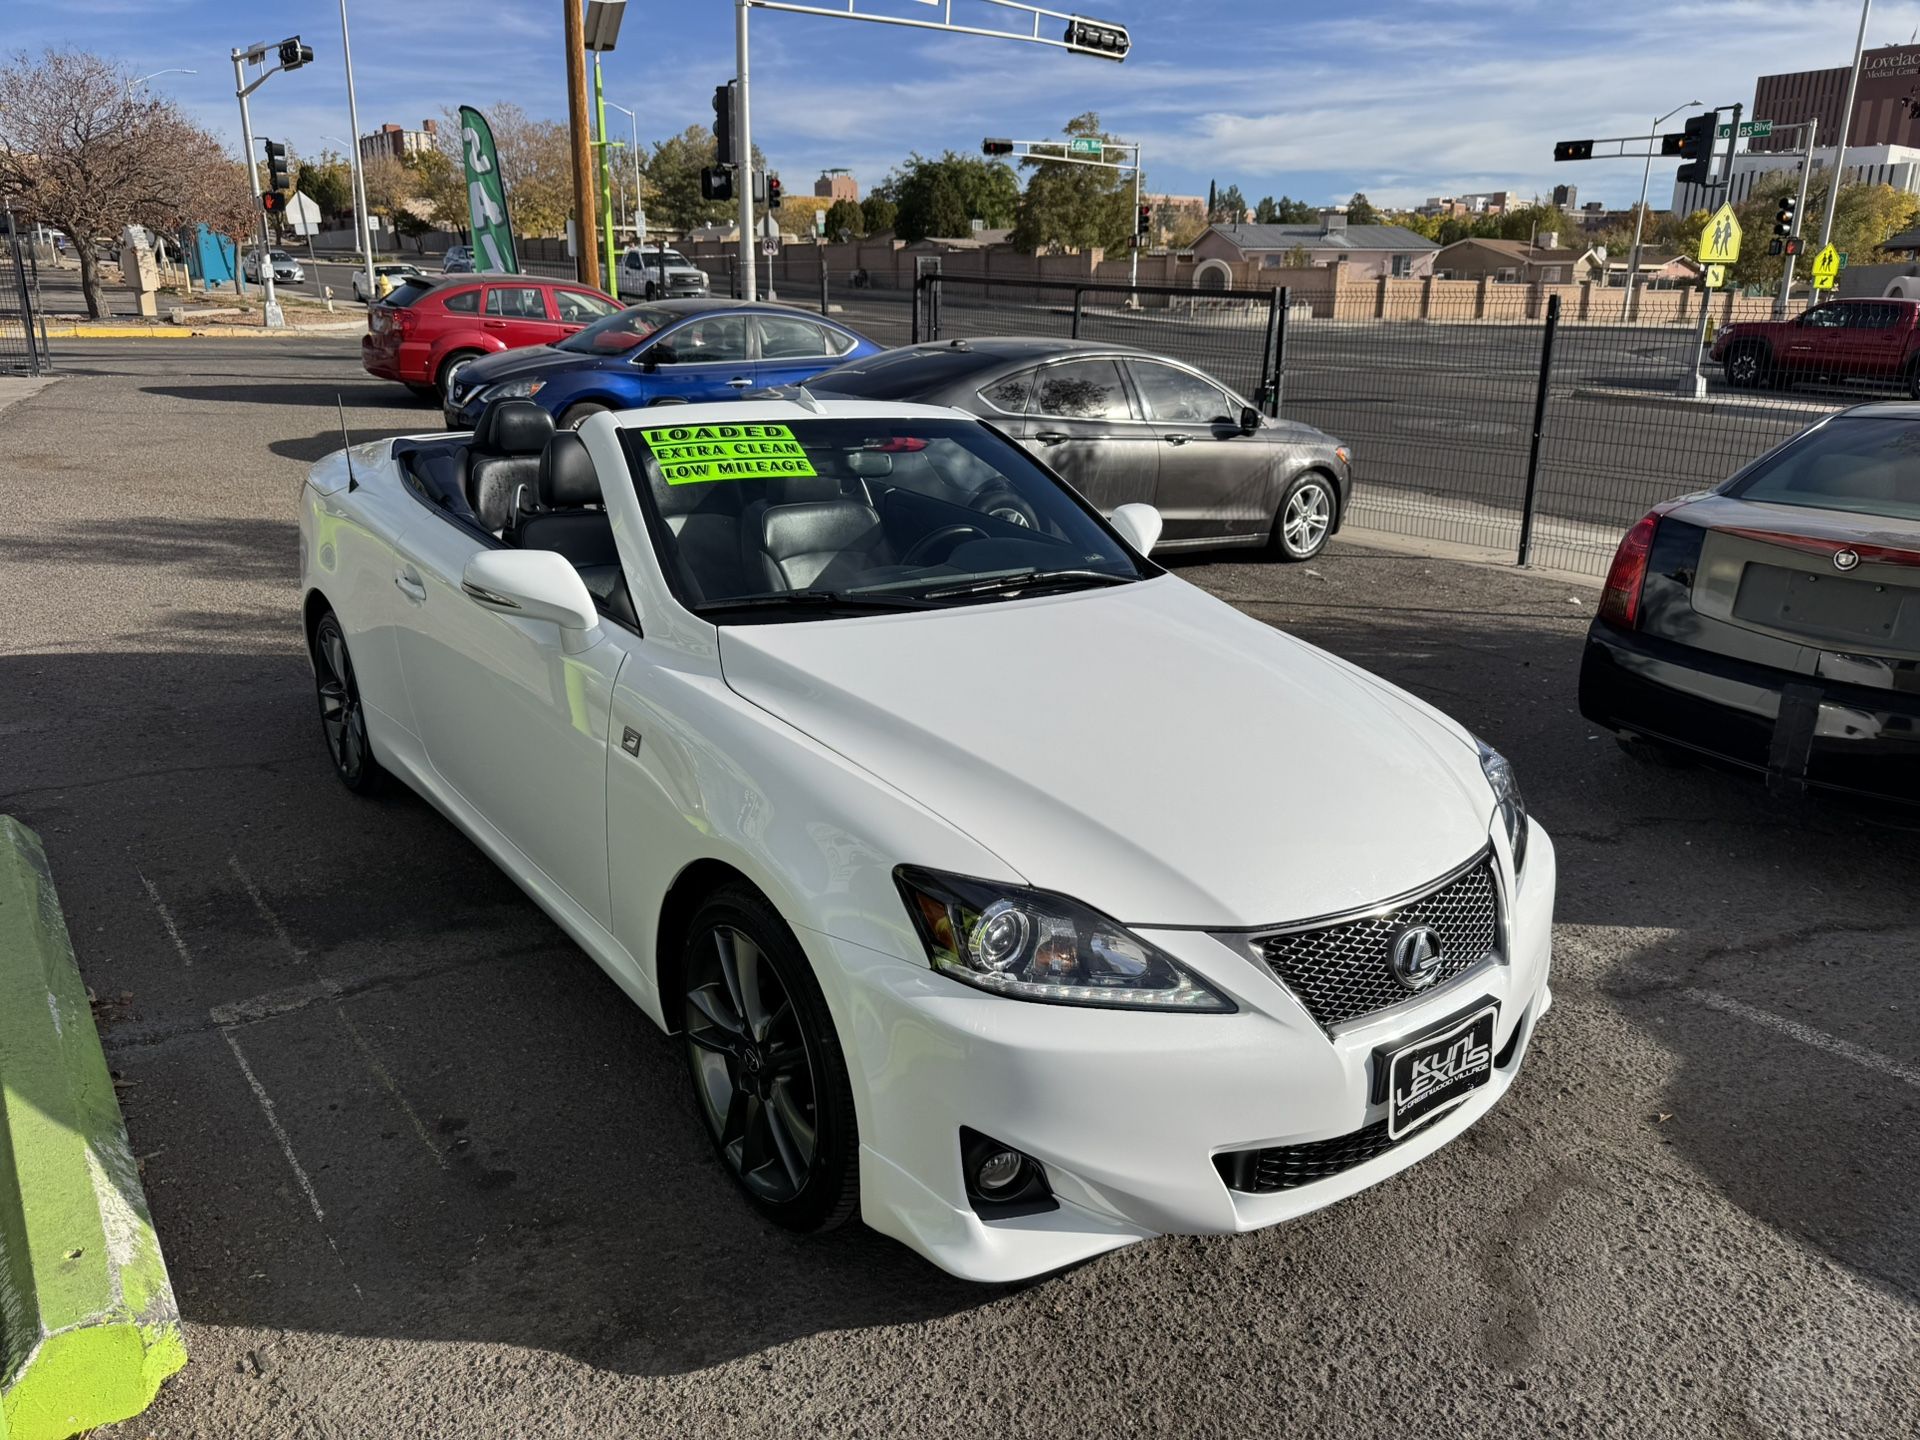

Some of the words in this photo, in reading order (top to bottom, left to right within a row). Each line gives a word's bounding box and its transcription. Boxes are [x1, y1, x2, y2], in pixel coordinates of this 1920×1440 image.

[1866, 68, 1894, 79] Medical
[1717, 126, 1753, 138] Loas
[1754, 122, 1772, 132] Blvd
[650, 426, 785, 443] LOADED
[657, 444, 726, 461] EXTRA
[733, 442, 801, 455] CLEAN
[665, 464, 710, 479] LOW
[717, 460, 811, 475] MILEAGE
[1396, 1043, 1490, 1106] LEXUS
[1397, 1104, 1408, 1116] OF
[1408, 1078, 1453, 1109] GREENWOOD
[1454, 1062, 1490, 1082] VILLAGE
